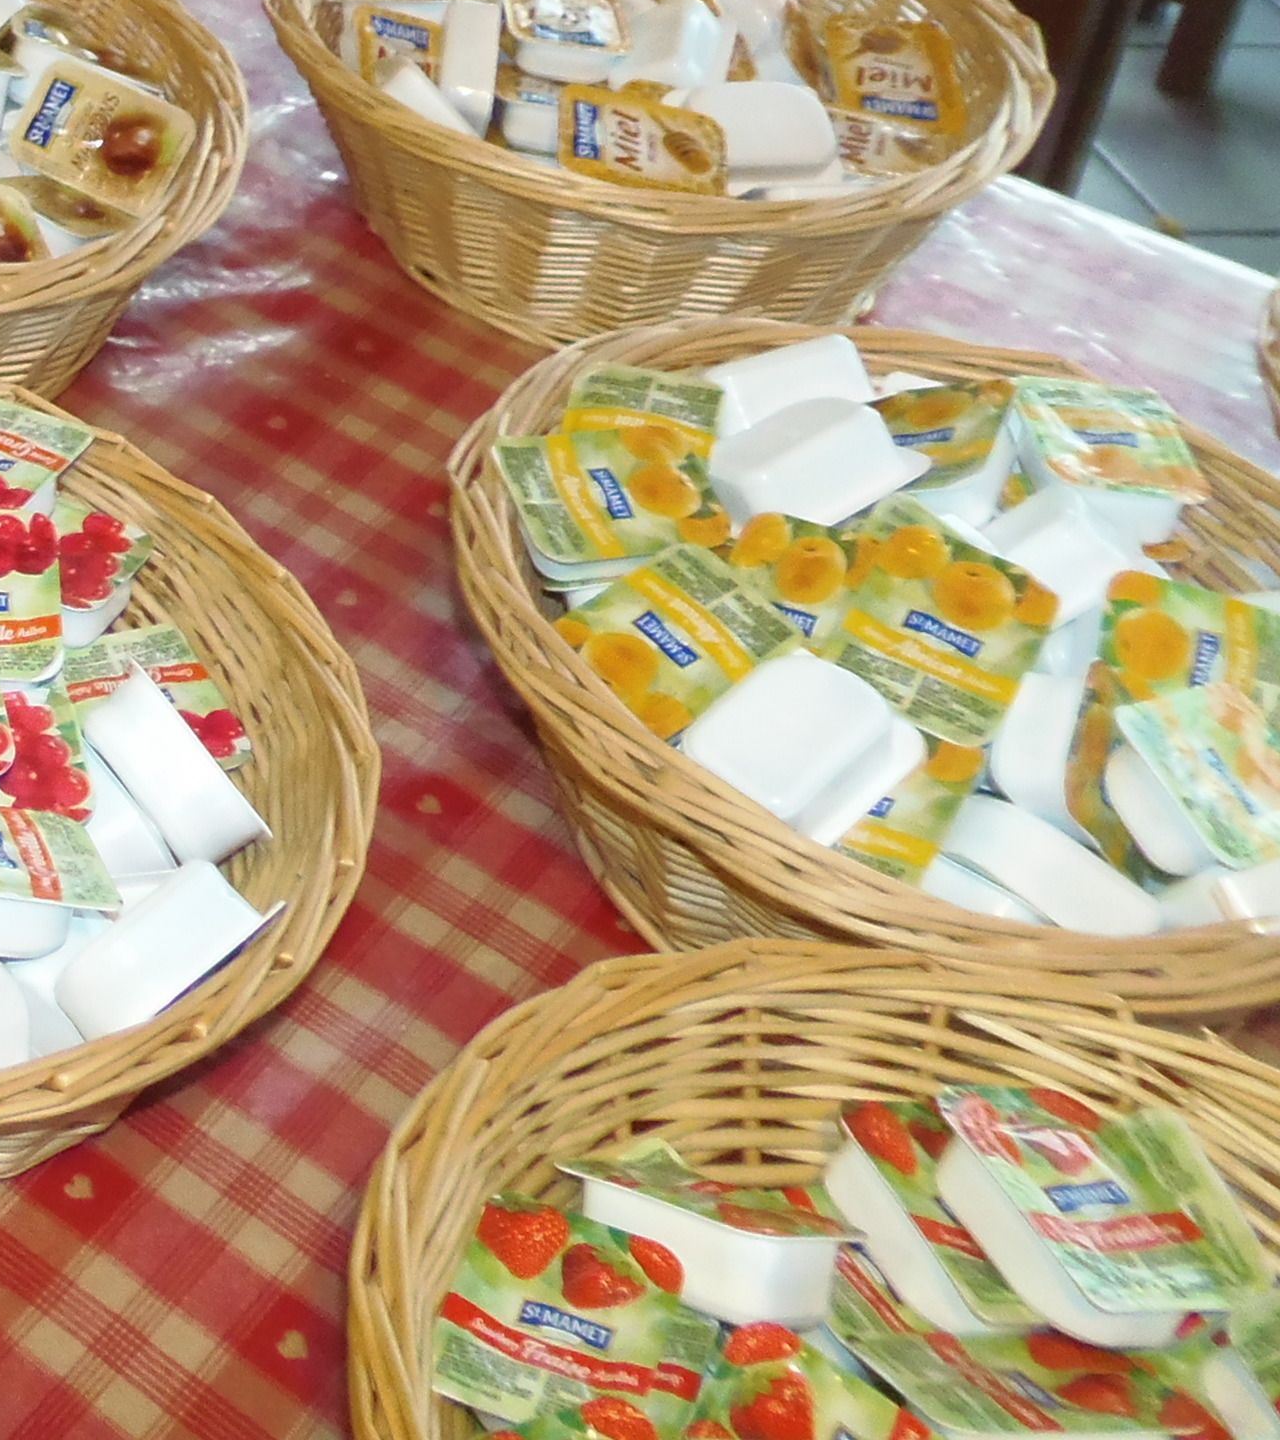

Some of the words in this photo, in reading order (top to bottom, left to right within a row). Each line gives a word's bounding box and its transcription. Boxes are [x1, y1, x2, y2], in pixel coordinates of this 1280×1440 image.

[857, 66, 932, 92] Miel
[611, 109, 643, 172] Miel
[839, 116, 872, 164] Miel
[520, 1338, 592, 1378] Fraise
